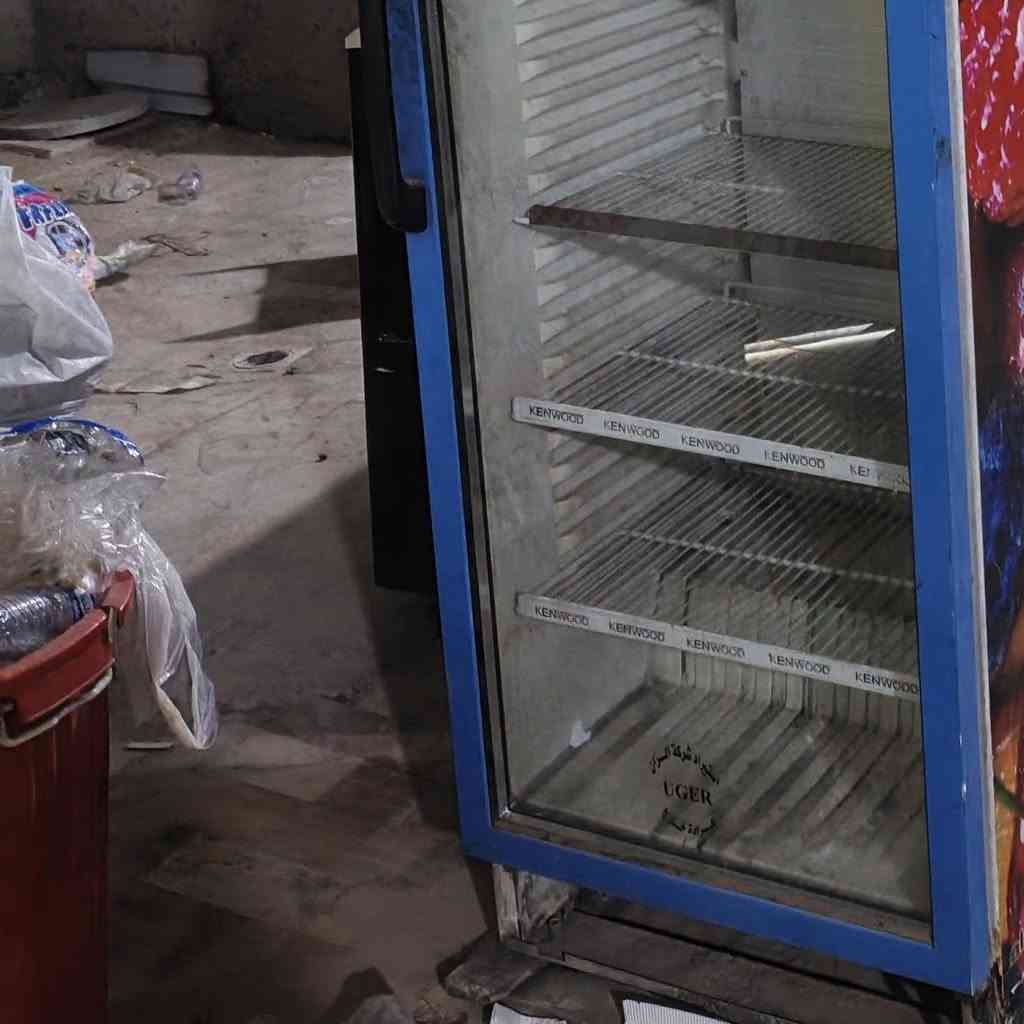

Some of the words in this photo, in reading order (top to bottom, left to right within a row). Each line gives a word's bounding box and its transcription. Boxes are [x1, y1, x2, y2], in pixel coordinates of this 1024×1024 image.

[528, 404, 585, 425] KENWOOD
[603, 419, 661, 440] KENWOOD
[681, 433, 740, 455] KENWOOD
[534, 605, 590, 626] KENWOOD
[608, 621, 666, 643] KENWOOD
[686, 637, 746, 658] KENWOOD
[767, 652, 831, 676] KENWOOD
[663, 778, 713, 807] UGER
